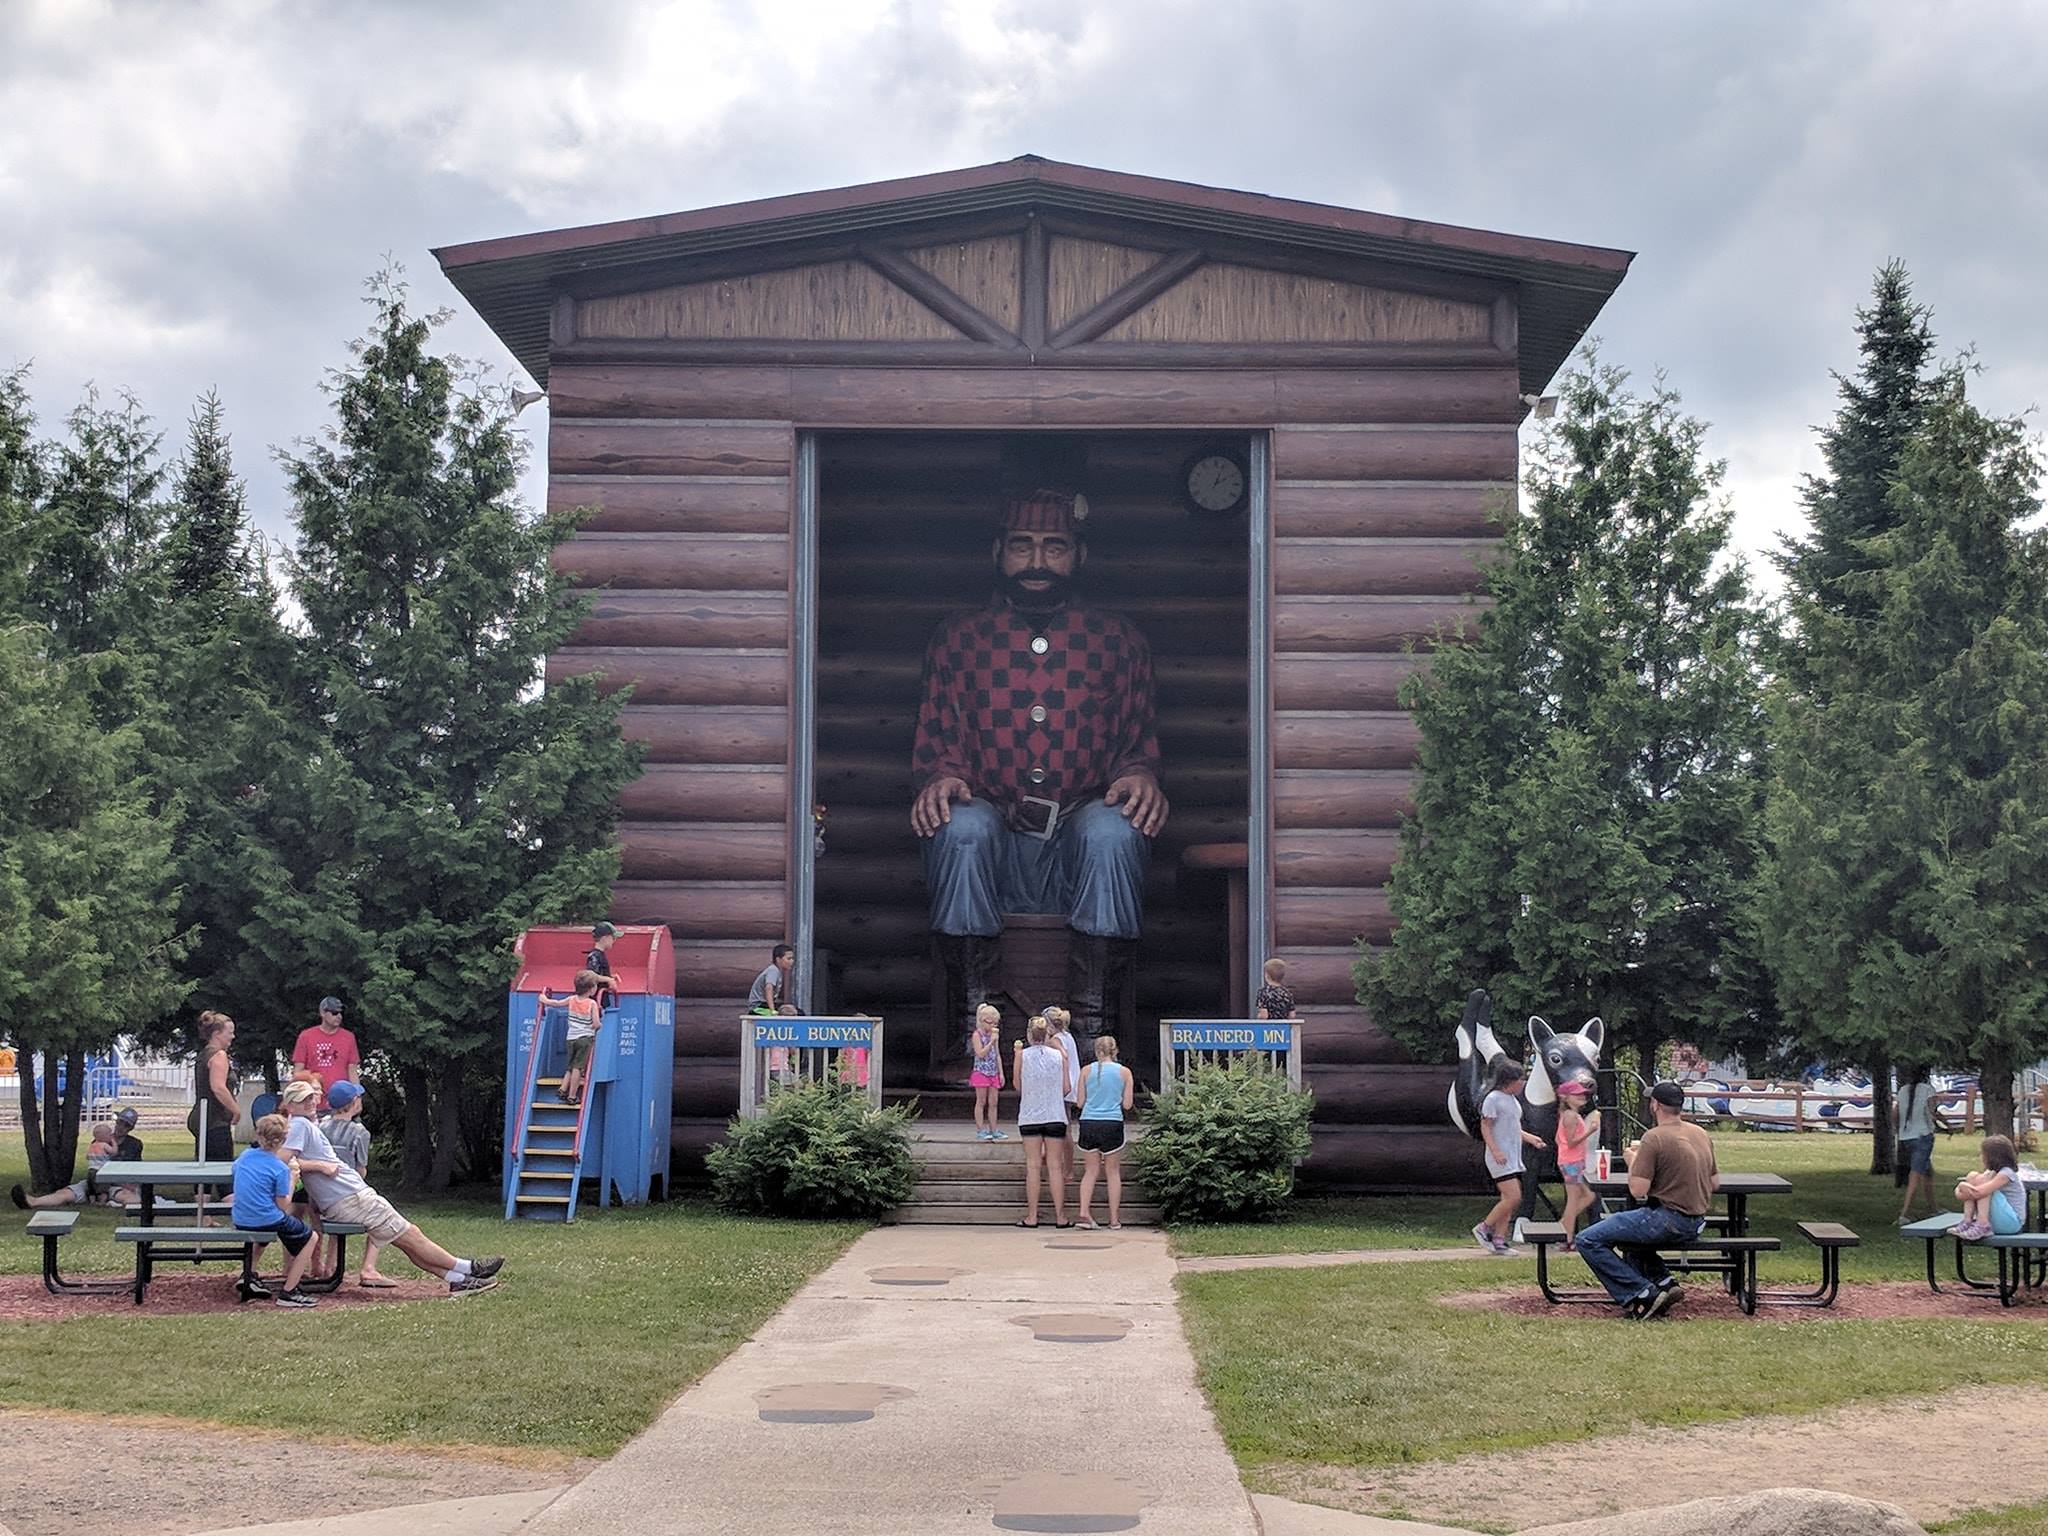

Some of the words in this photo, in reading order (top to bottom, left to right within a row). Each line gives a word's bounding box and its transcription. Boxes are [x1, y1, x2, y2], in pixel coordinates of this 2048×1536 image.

[755, 1026, 799, 1041] PAUL
[807, 1026, 871, 1041] BUNYAN
[1173, 1029, 1254, 1043] BRAINERD
[1263, 1029, 1290, 1043] MN.
